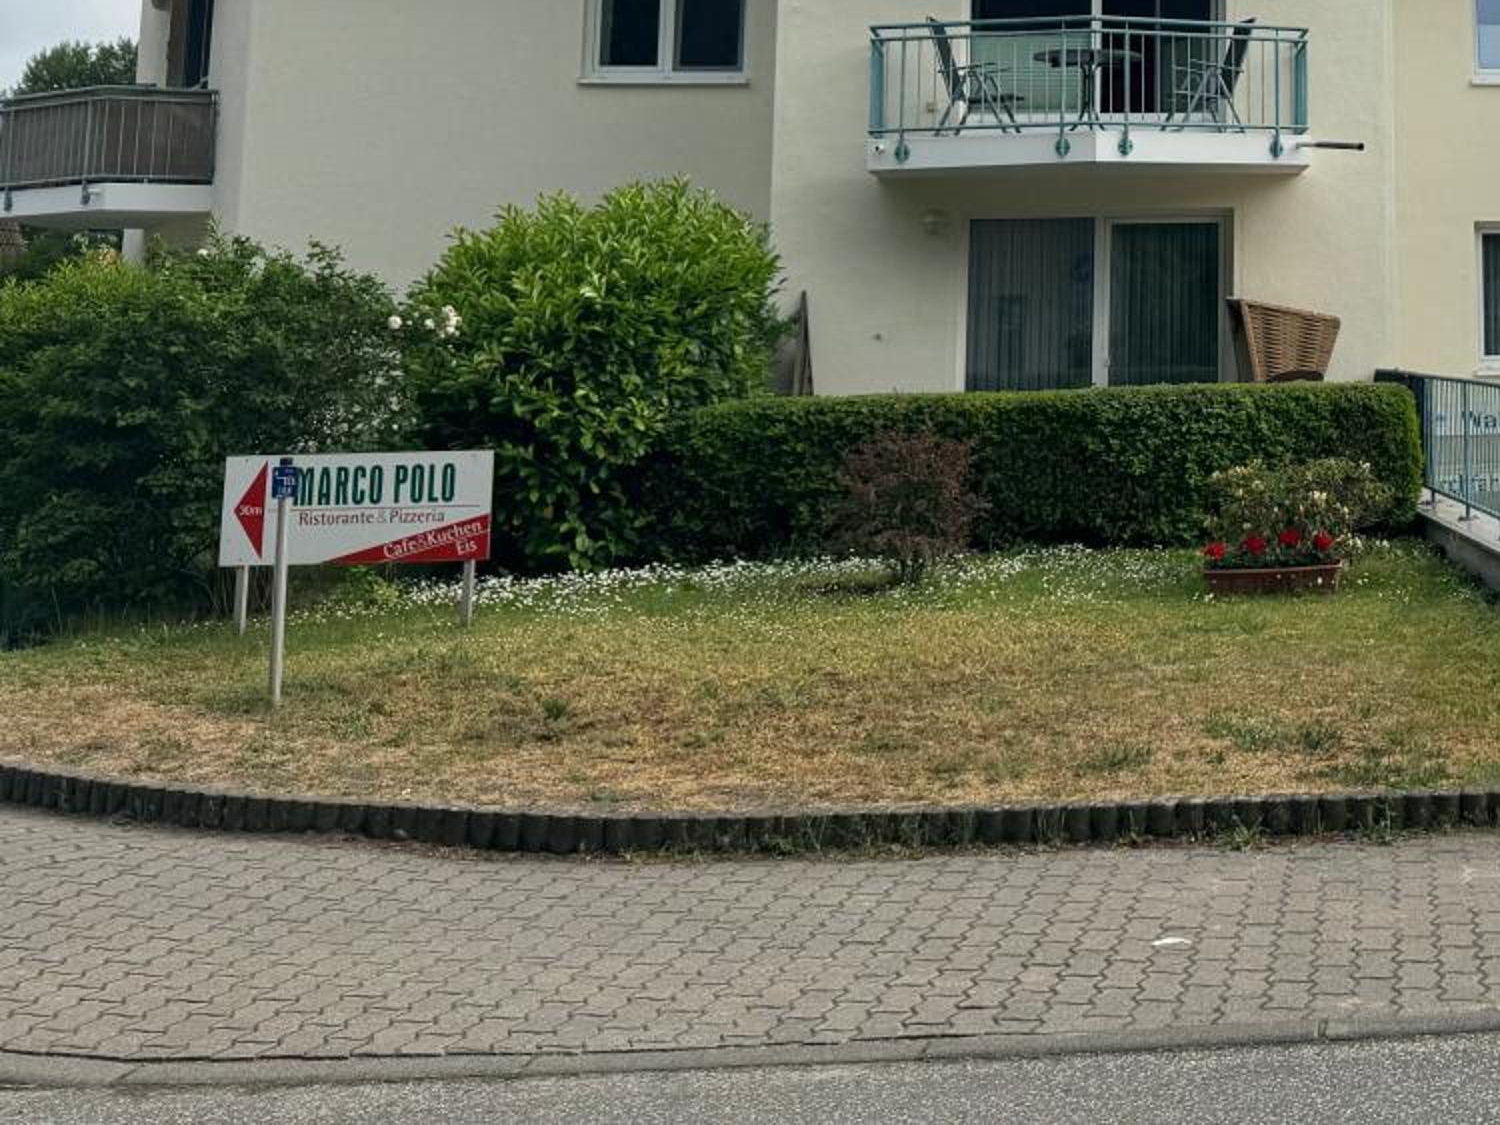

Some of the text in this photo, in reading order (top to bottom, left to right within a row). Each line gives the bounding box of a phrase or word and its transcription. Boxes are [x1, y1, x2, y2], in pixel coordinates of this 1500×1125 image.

[293, 464, 384, 507] MARCO
[393, 462, 456, 504] POLO
[299, 508, 374, 526] Ristorante
[389, 508, 445, 524] Pizzeria
[456, 540, 477, 556] Eis
